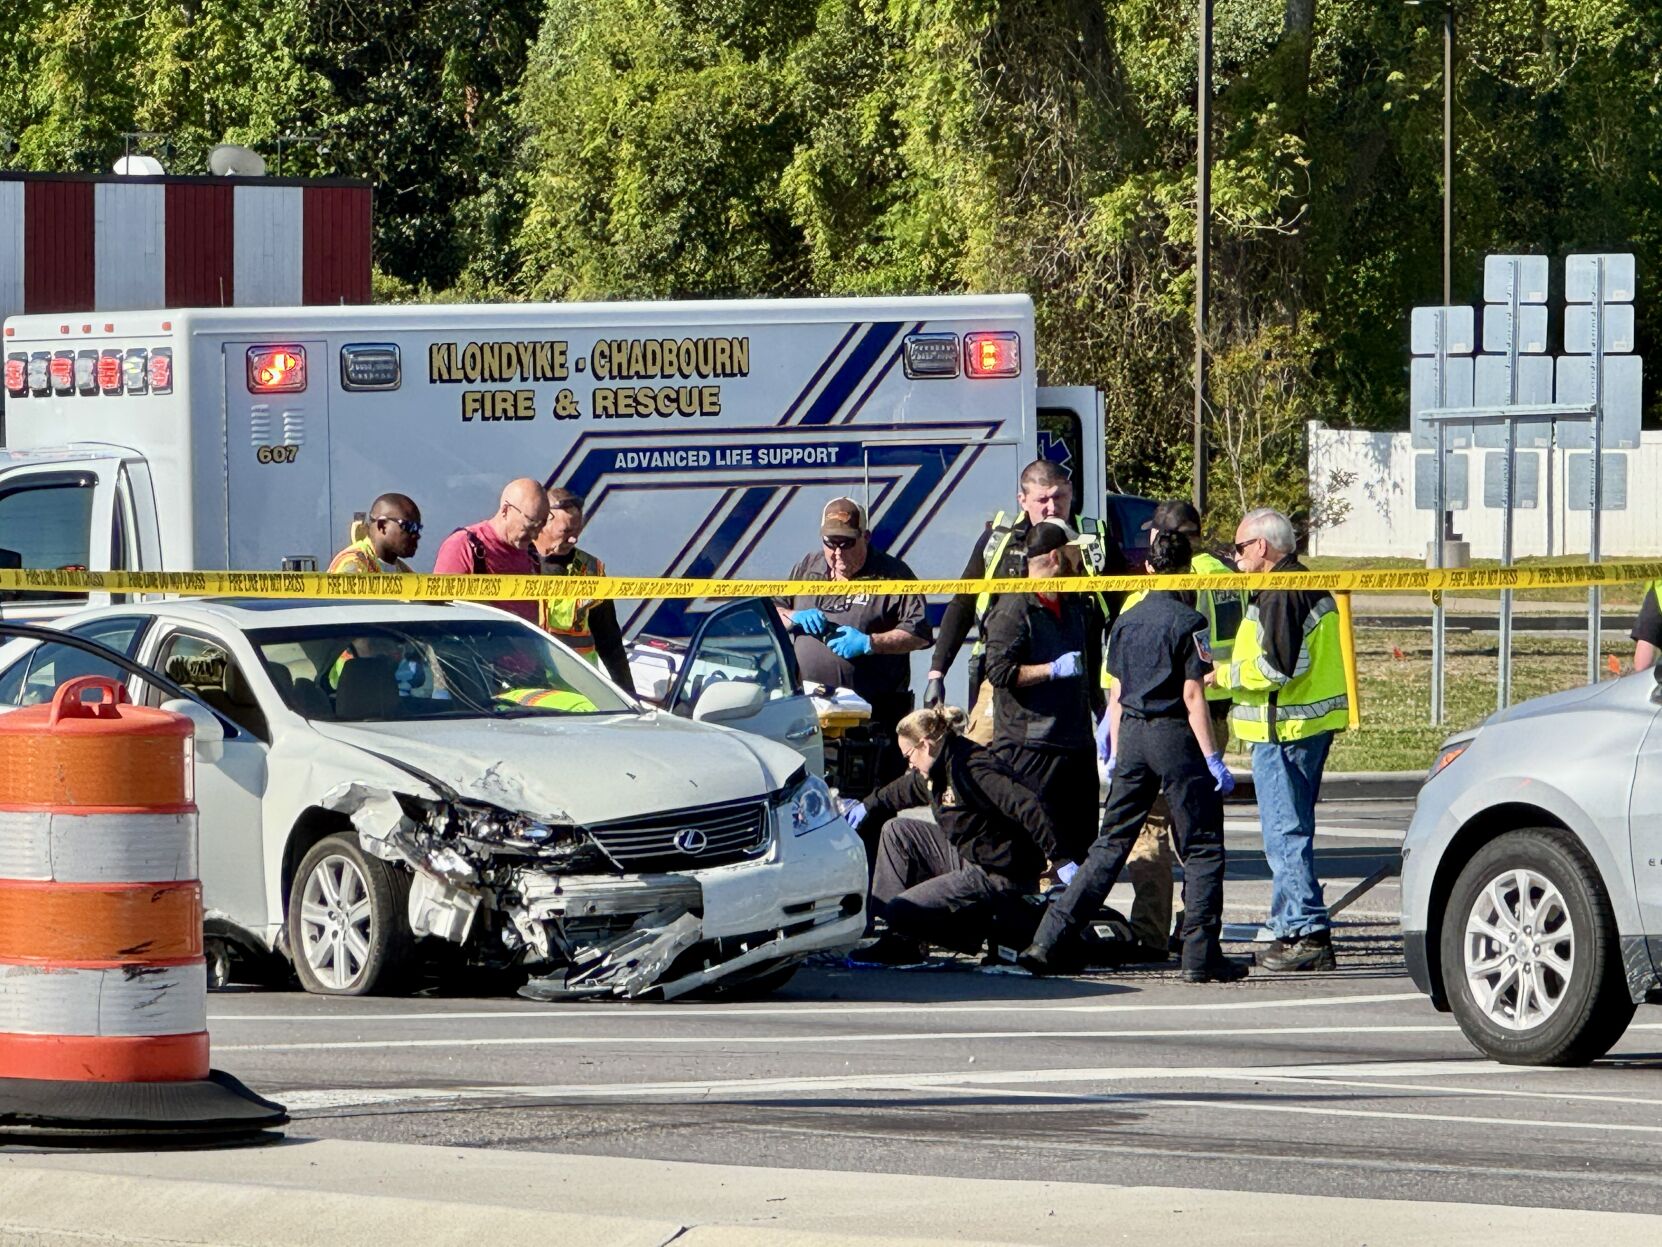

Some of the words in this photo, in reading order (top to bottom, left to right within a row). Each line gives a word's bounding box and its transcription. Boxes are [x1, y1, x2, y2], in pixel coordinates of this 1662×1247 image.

[430, 341, 568, 384] KLONDYKE
[591, 337, 749, 381] CHADBOURN
[462, 390, 535, 421] FIRE
[553, 388, 581, 420] &
[592, 385, 721, 418] RESCUE
[257, 445, 299, 464] 607
[615, 452, 710, 468] ADVANCED
[716, 450, 752, 466] LIFE
[758, 447, 839, 464] SUPPORT
